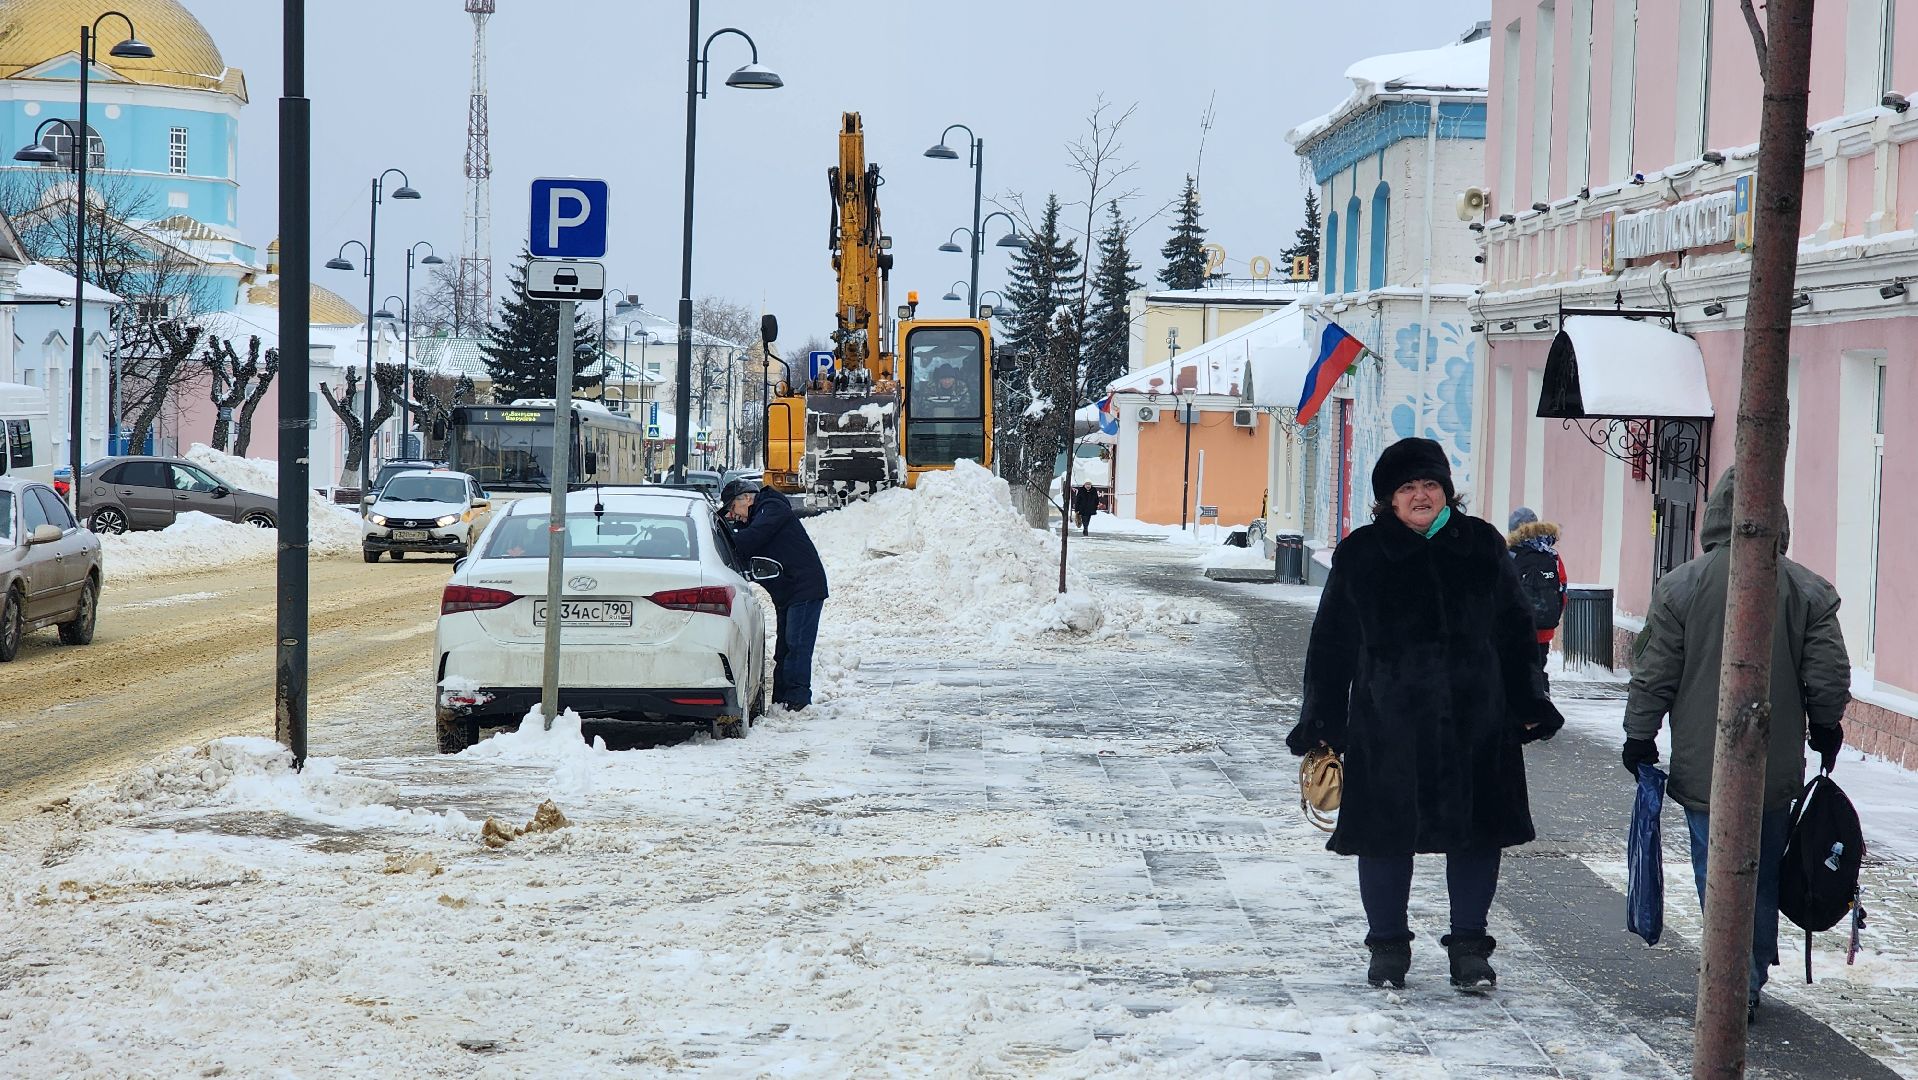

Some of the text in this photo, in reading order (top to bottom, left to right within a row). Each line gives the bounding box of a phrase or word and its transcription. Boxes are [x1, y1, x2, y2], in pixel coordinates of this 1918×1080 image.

[549, 188, 591, 248] P
[1617, 213, 1658, 258] ШКОЛА
[484, 411, 489, 420] 1
[539, 603, 627, 620] С34АС 790
